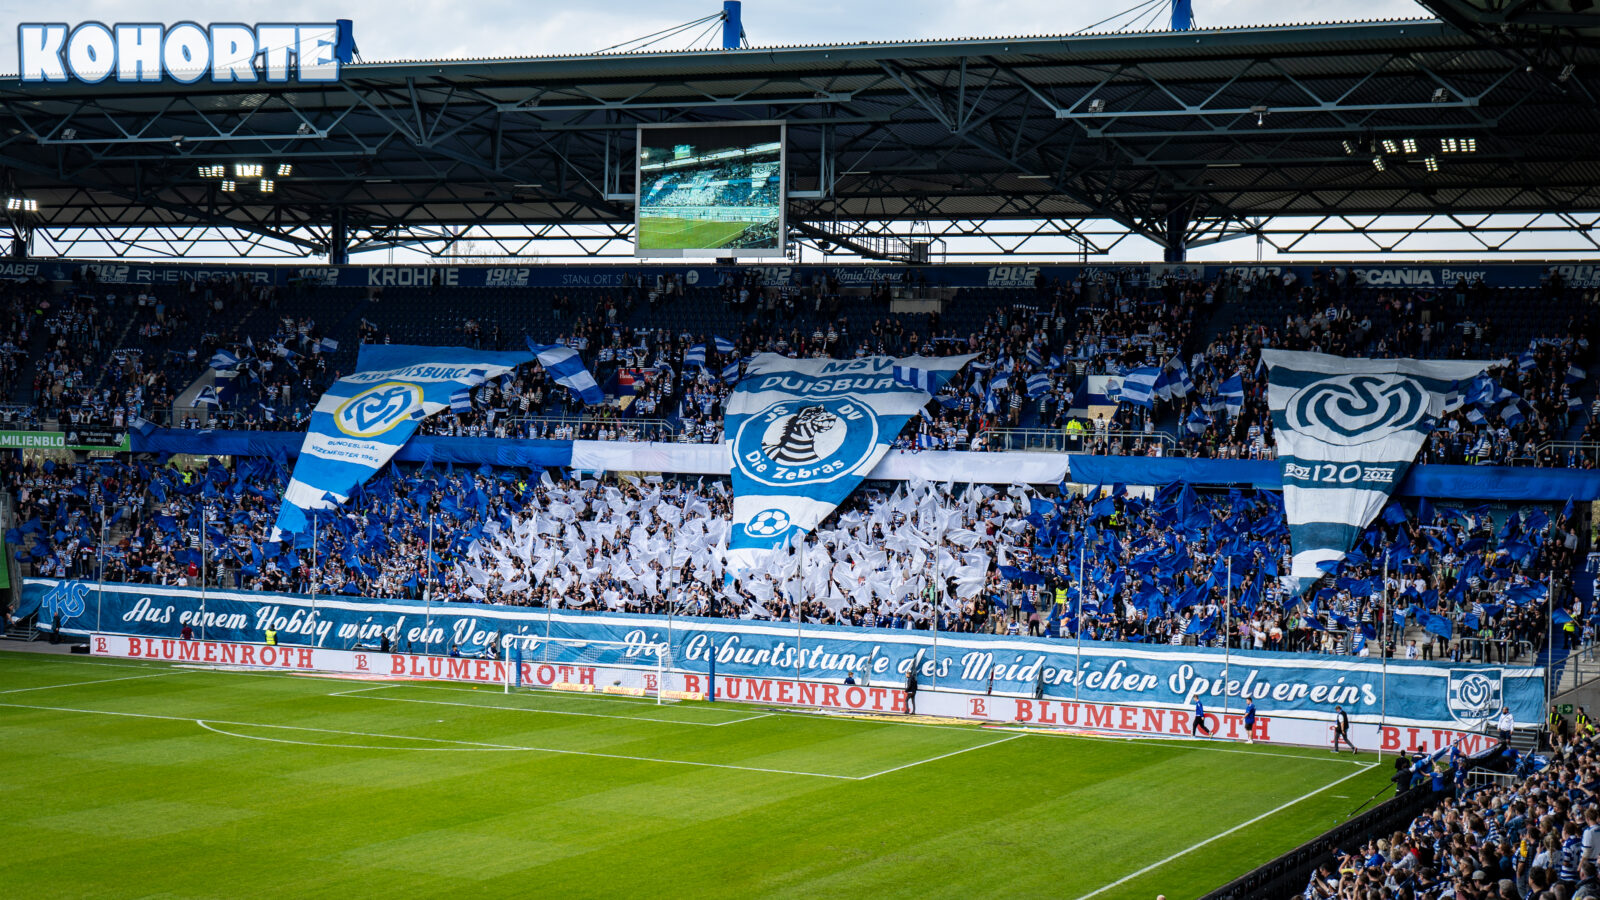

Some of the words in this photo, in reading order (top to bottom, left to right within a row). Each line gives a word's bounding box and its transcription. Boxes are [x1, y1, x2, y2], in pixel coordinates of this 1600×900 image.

[368, 267, 459, 286] KROHNE
[486, 268, 530, 281] 1902
[987, 267, 1040, 281] 1902
[1353, 267, 1435, 285] SCANIA
[1441, 268, 1487, 280] Breuer
[821, 357, 895, 374] MSV
[745, 449, 768, 473] Die
[772, 459, 845, 480] Zebras
[1312, 463, 1362, 482] 120
[122, 597, 175, 624] Aus
[179, 604, 248, 631] einem
[255, 605, 334, 648] Hobby
[407, 620, 446, 645] ein
[624, 629, 670, 658] Die
[685, 634, 889, 674] Geburtsstunde
[897, 647, 953, 678] des
[960, 651, 1159, 693] Meidericher
[1168, 663, 1377, 706] Spielvereins
[127, 637, 314, 669] BLUMENROTH
[390, 654, 597, 690] BLUMENROTH
[683, 674, 911, 713] BLUMENROTH
[1014, 698, 1271, 741] BLUMENROTH
